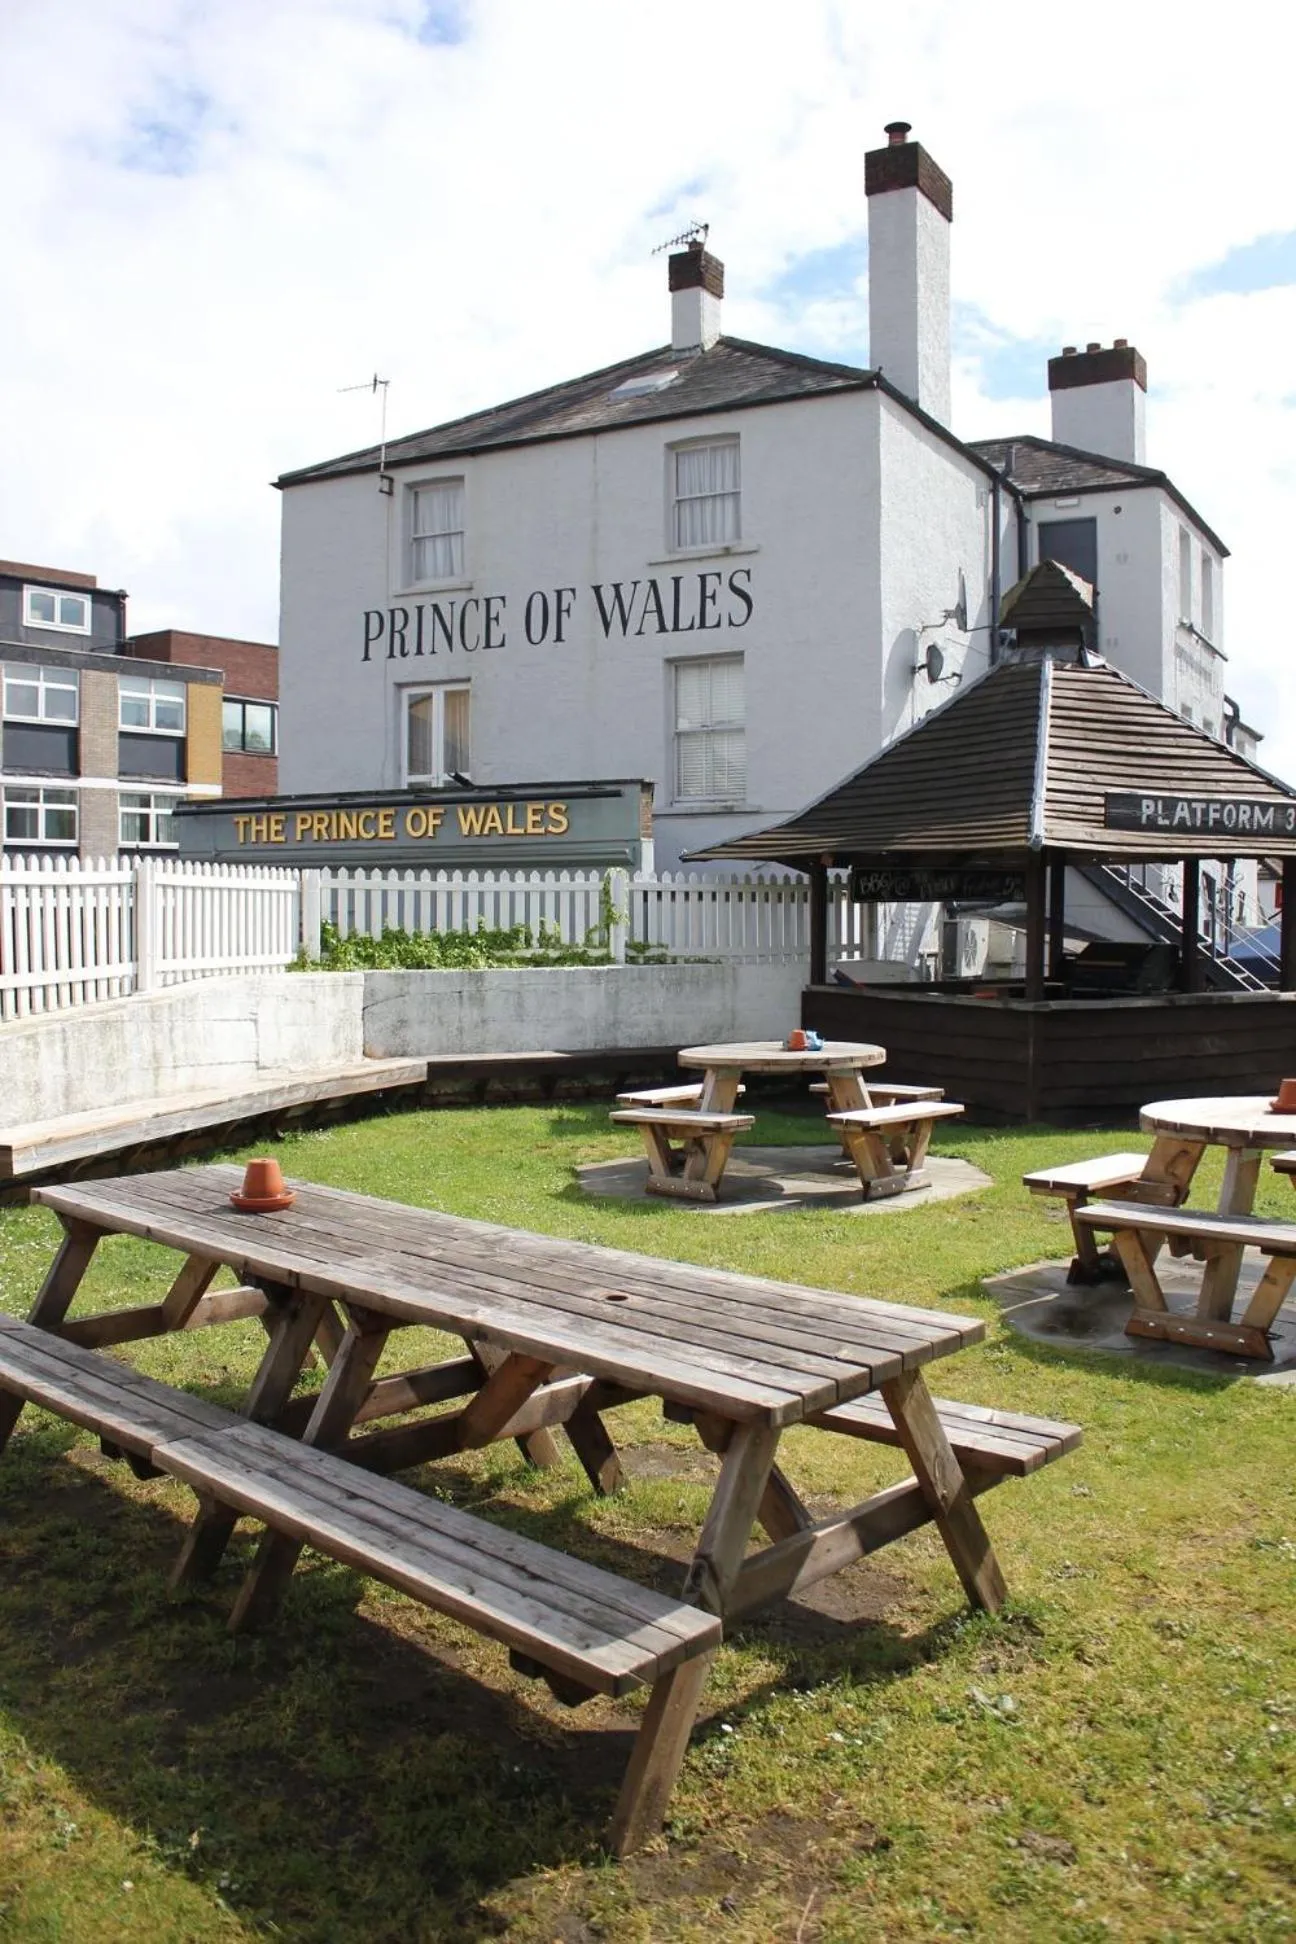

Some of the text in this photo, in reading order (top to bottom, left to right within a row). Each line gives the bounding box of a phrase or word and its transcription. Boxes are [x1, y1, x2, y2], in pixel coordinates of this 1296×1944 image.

[361, 568, 754, 662] PRINCE OF WALES
[234, 802, 570, 844] THE PRINCE OF WALES
[1141, 799, 1295, 831] PLATFORM 3
